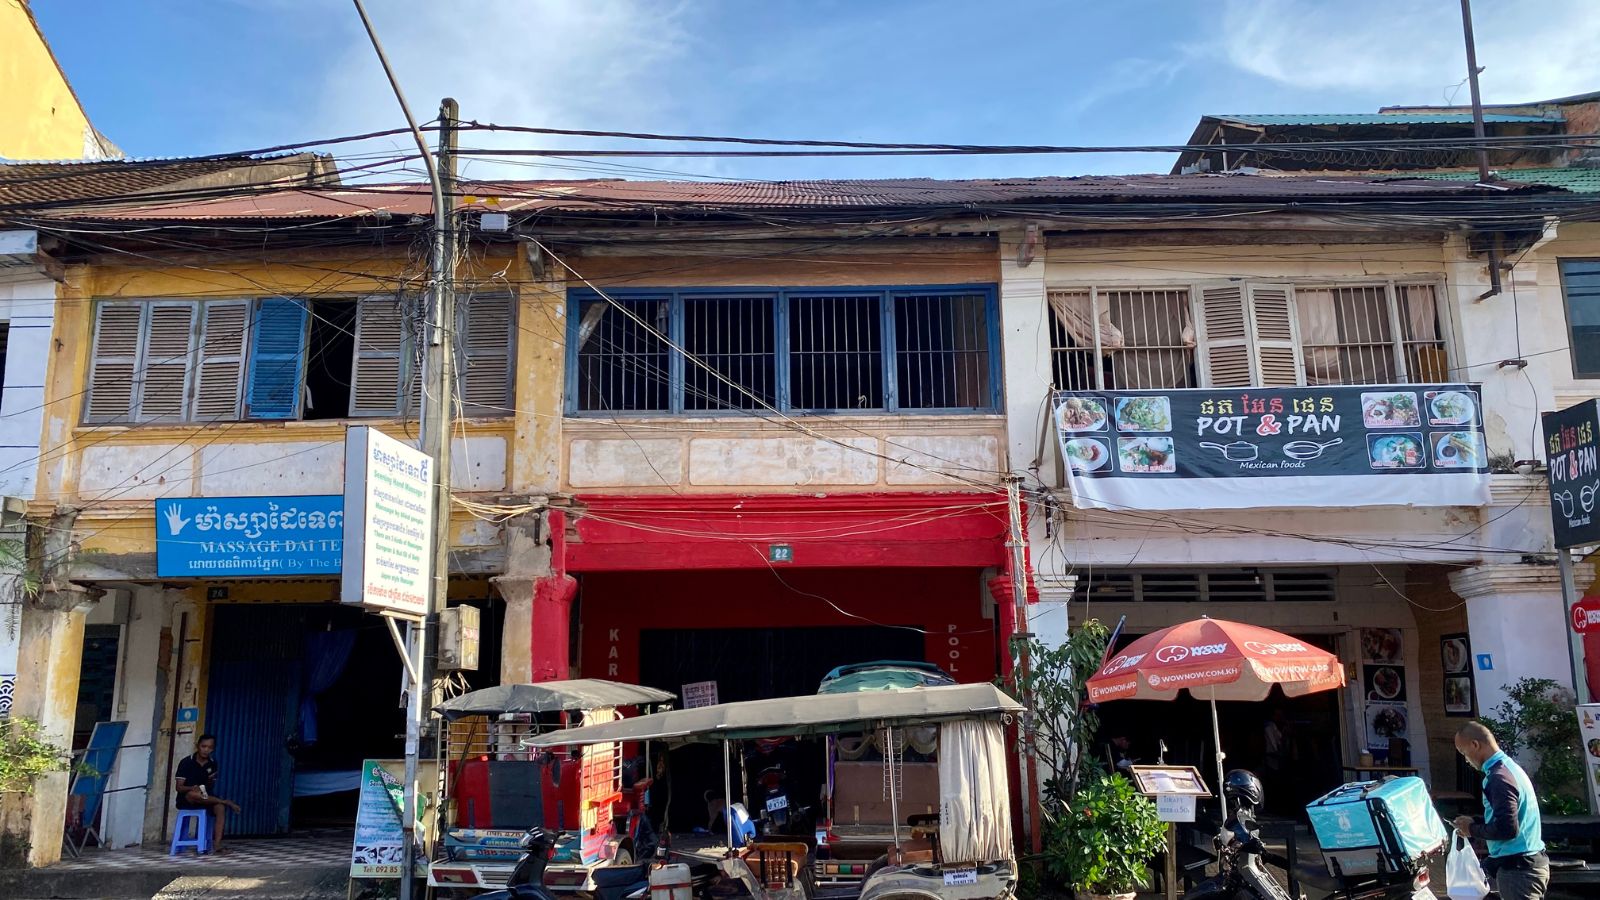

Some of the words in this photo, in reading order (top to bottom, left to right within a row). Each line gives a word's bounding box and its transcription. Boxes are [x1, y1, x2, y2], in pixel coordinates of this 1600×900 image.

[1197, 415, 1249, 436] POT
[1256, 414, 1282, 436] &
[1287, 414, 1341, 436] PAN
[1240, 460, 1278, 469] Mexican
[1280, 460, 1306, 469] foods
[1550, 454, 1567, 484] POT
[1569, 450, 1579, 480] &
[1578, 446, 1597, 477] PAN
[200, 541, 280, 554] MASSAGE
[285, 540, 315, 553] DAI
[775, 548, 788, 559] 22
[288, 558, 303, 569] By
[308, 558, 330, 568] The
[947, 624, 960, 672] POOL
[1161, 667, 1239, 683] WOWNOW.COM.KH
